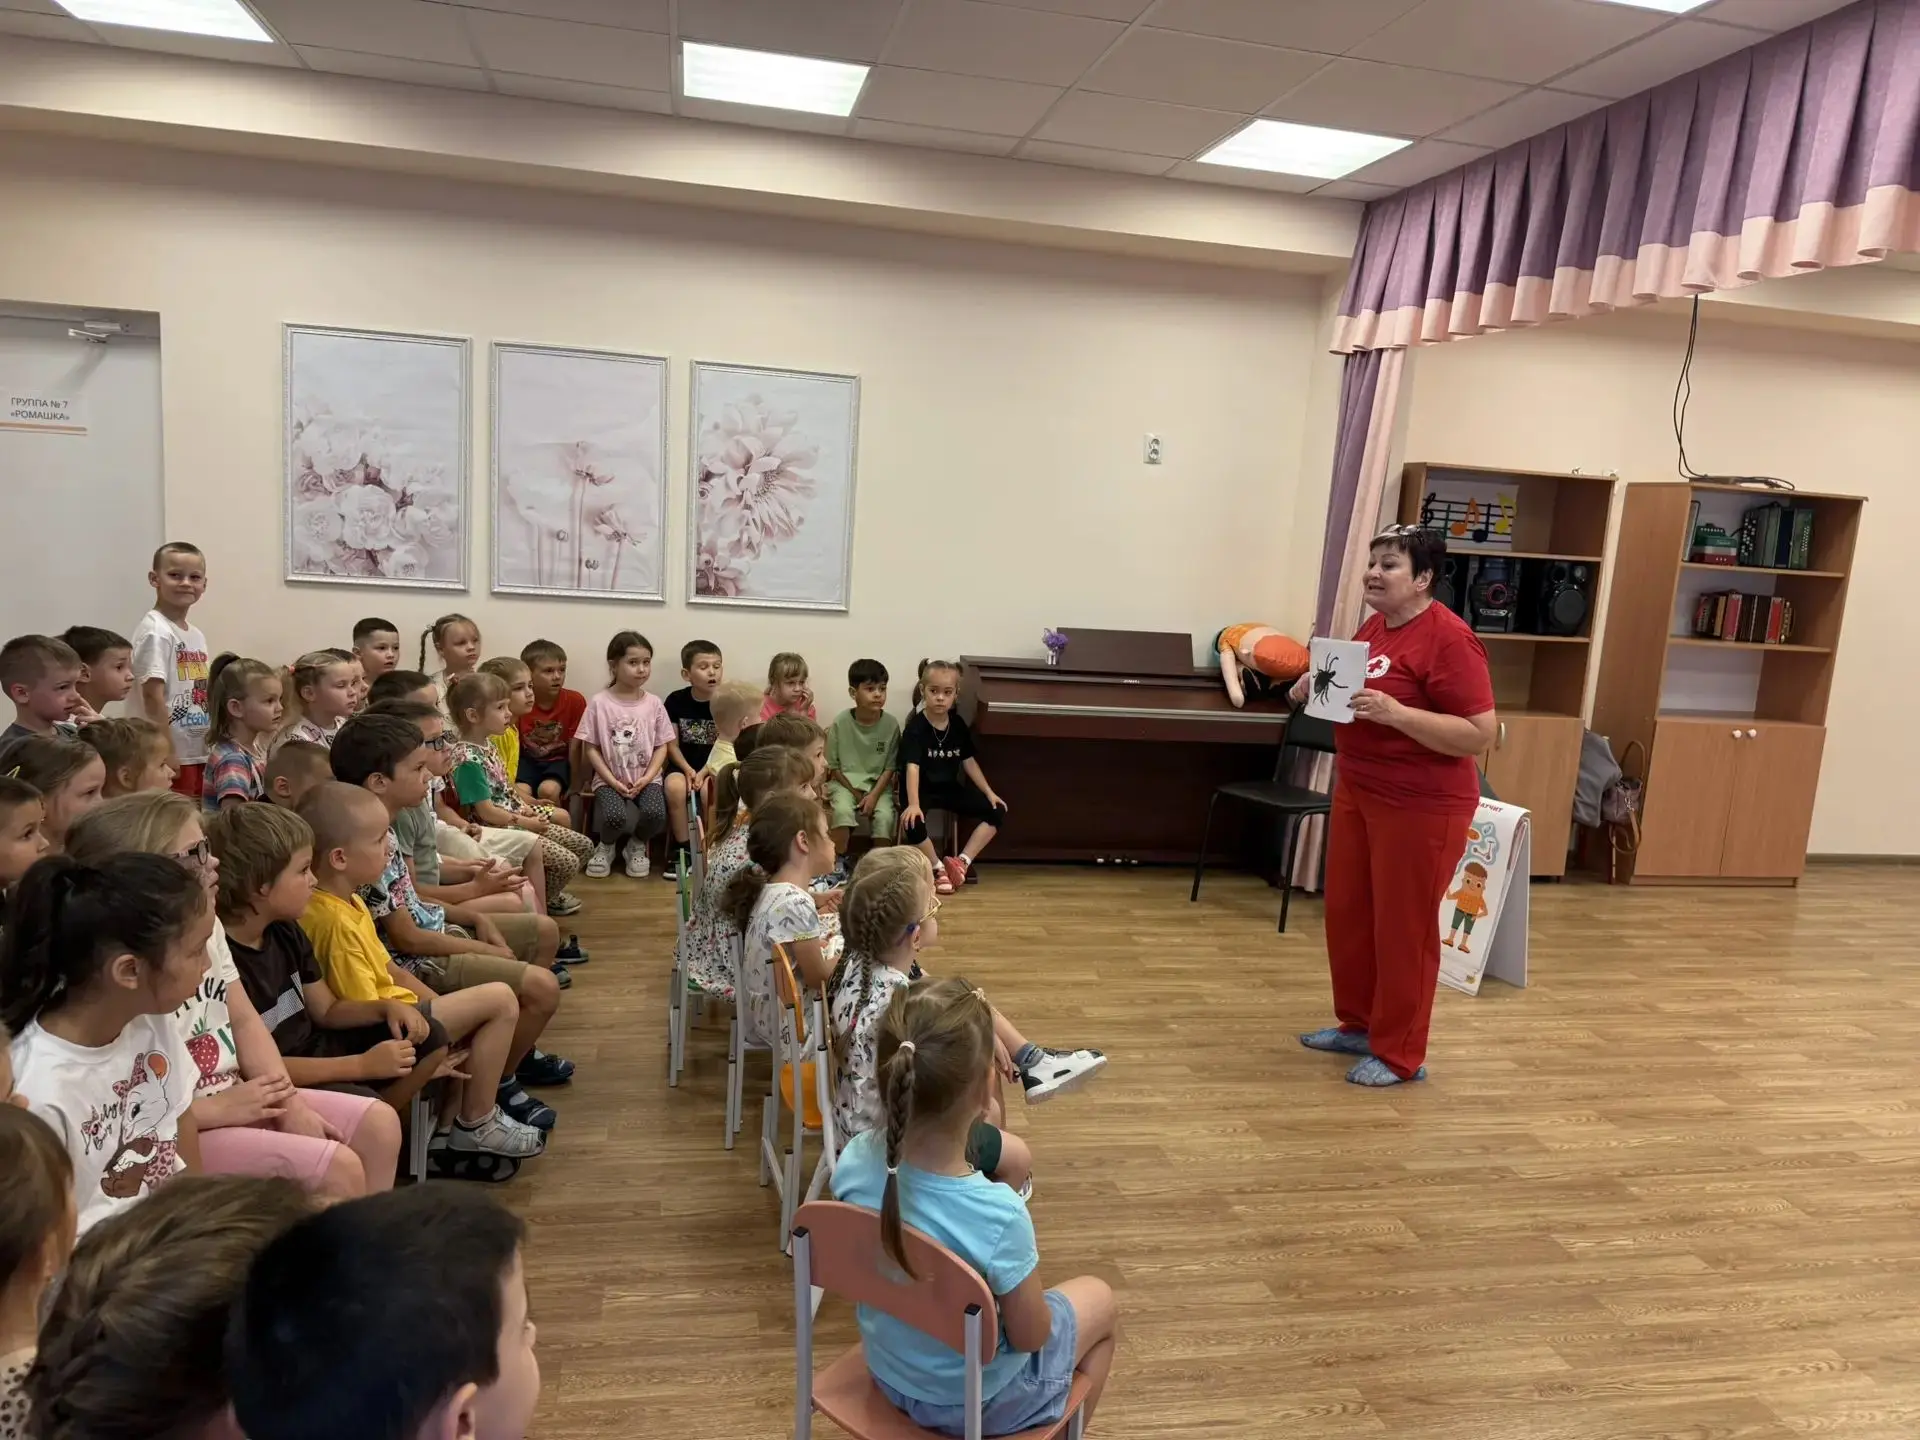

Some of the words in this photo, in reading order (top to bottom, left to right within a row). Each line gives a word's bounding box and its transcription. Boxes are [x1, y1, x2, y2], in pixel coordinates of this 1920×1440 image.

[11, 397, 48, 407] ГРУППА
[51, 400, 61, 408] №
[62, 400, 68, 408] 7
[10, 410, 70, 420] «РОМАШКА»
